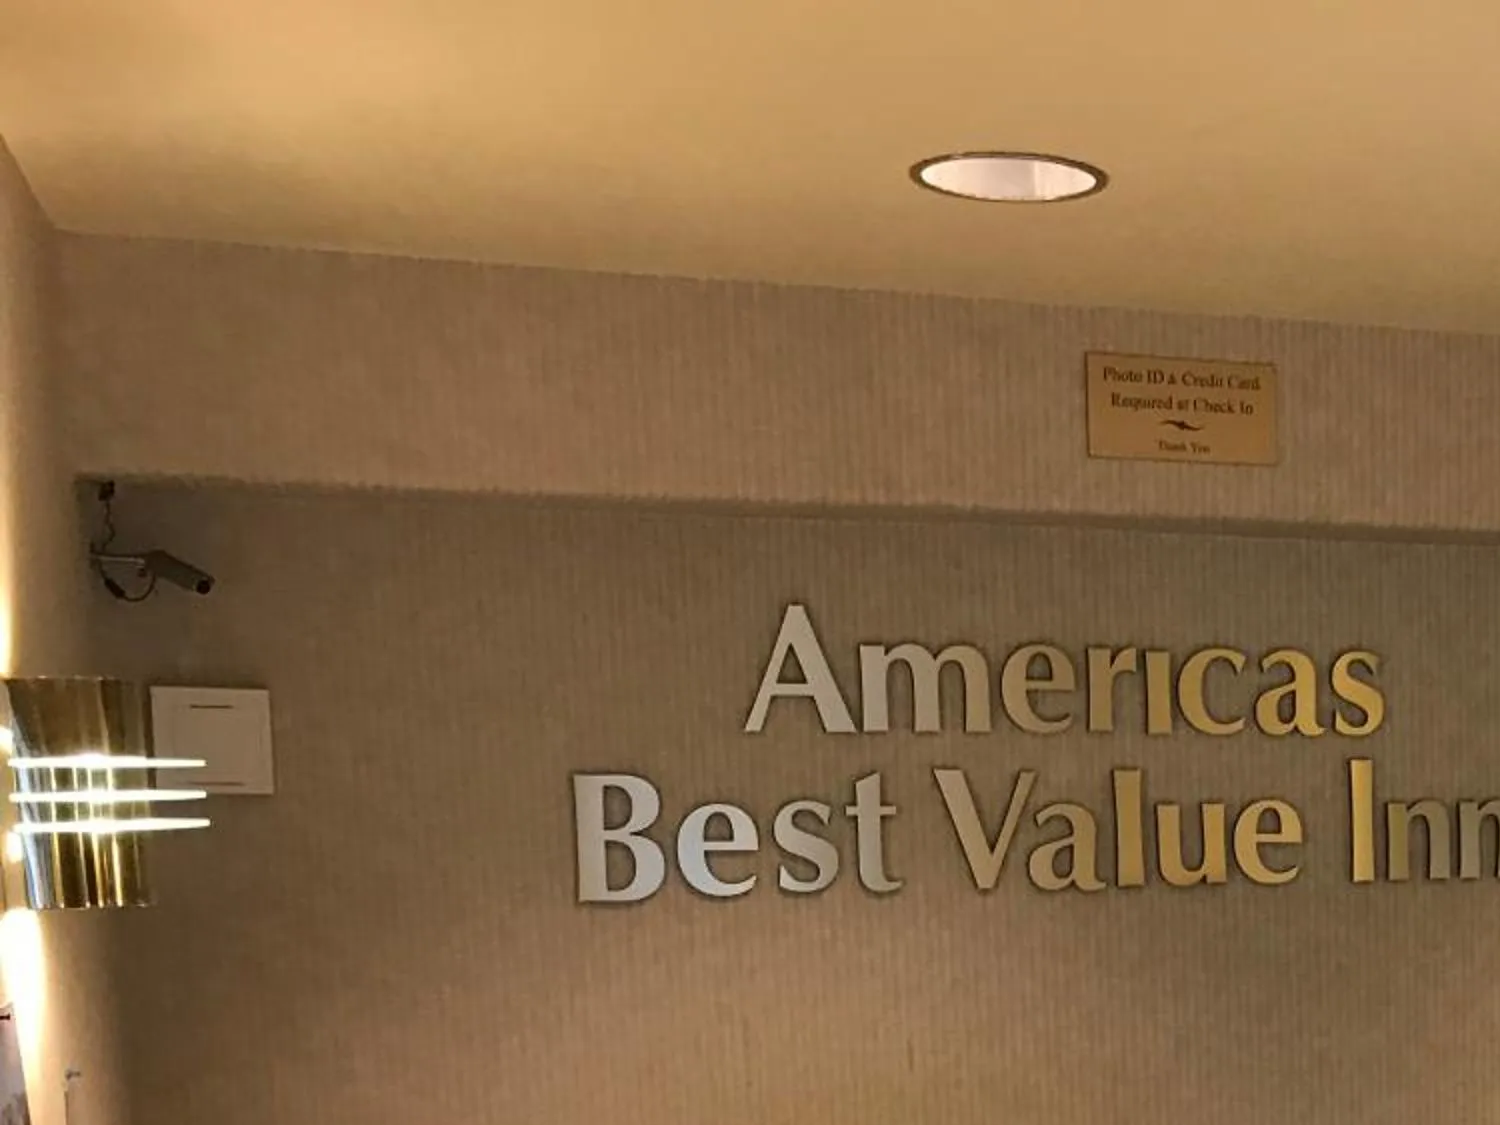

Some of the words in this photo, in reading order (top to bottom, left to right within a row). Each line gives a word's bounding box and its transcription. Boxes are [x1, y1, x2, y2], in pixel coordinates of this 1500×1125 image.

[1103, 366, 1143, 383] Photo
[1147, 369, 1165, 384] ID
[1181, 371, 1223, 388] Credit
[1227, 373, 1262, 391] Card
[1111, 392, 1174, 412] Required
[1193, 399, 1235, 414] Check
[743, 603, 1387, 738] Americas
[573, 771, 904, 904] Best
[932, 767, 1304, 892] Value
